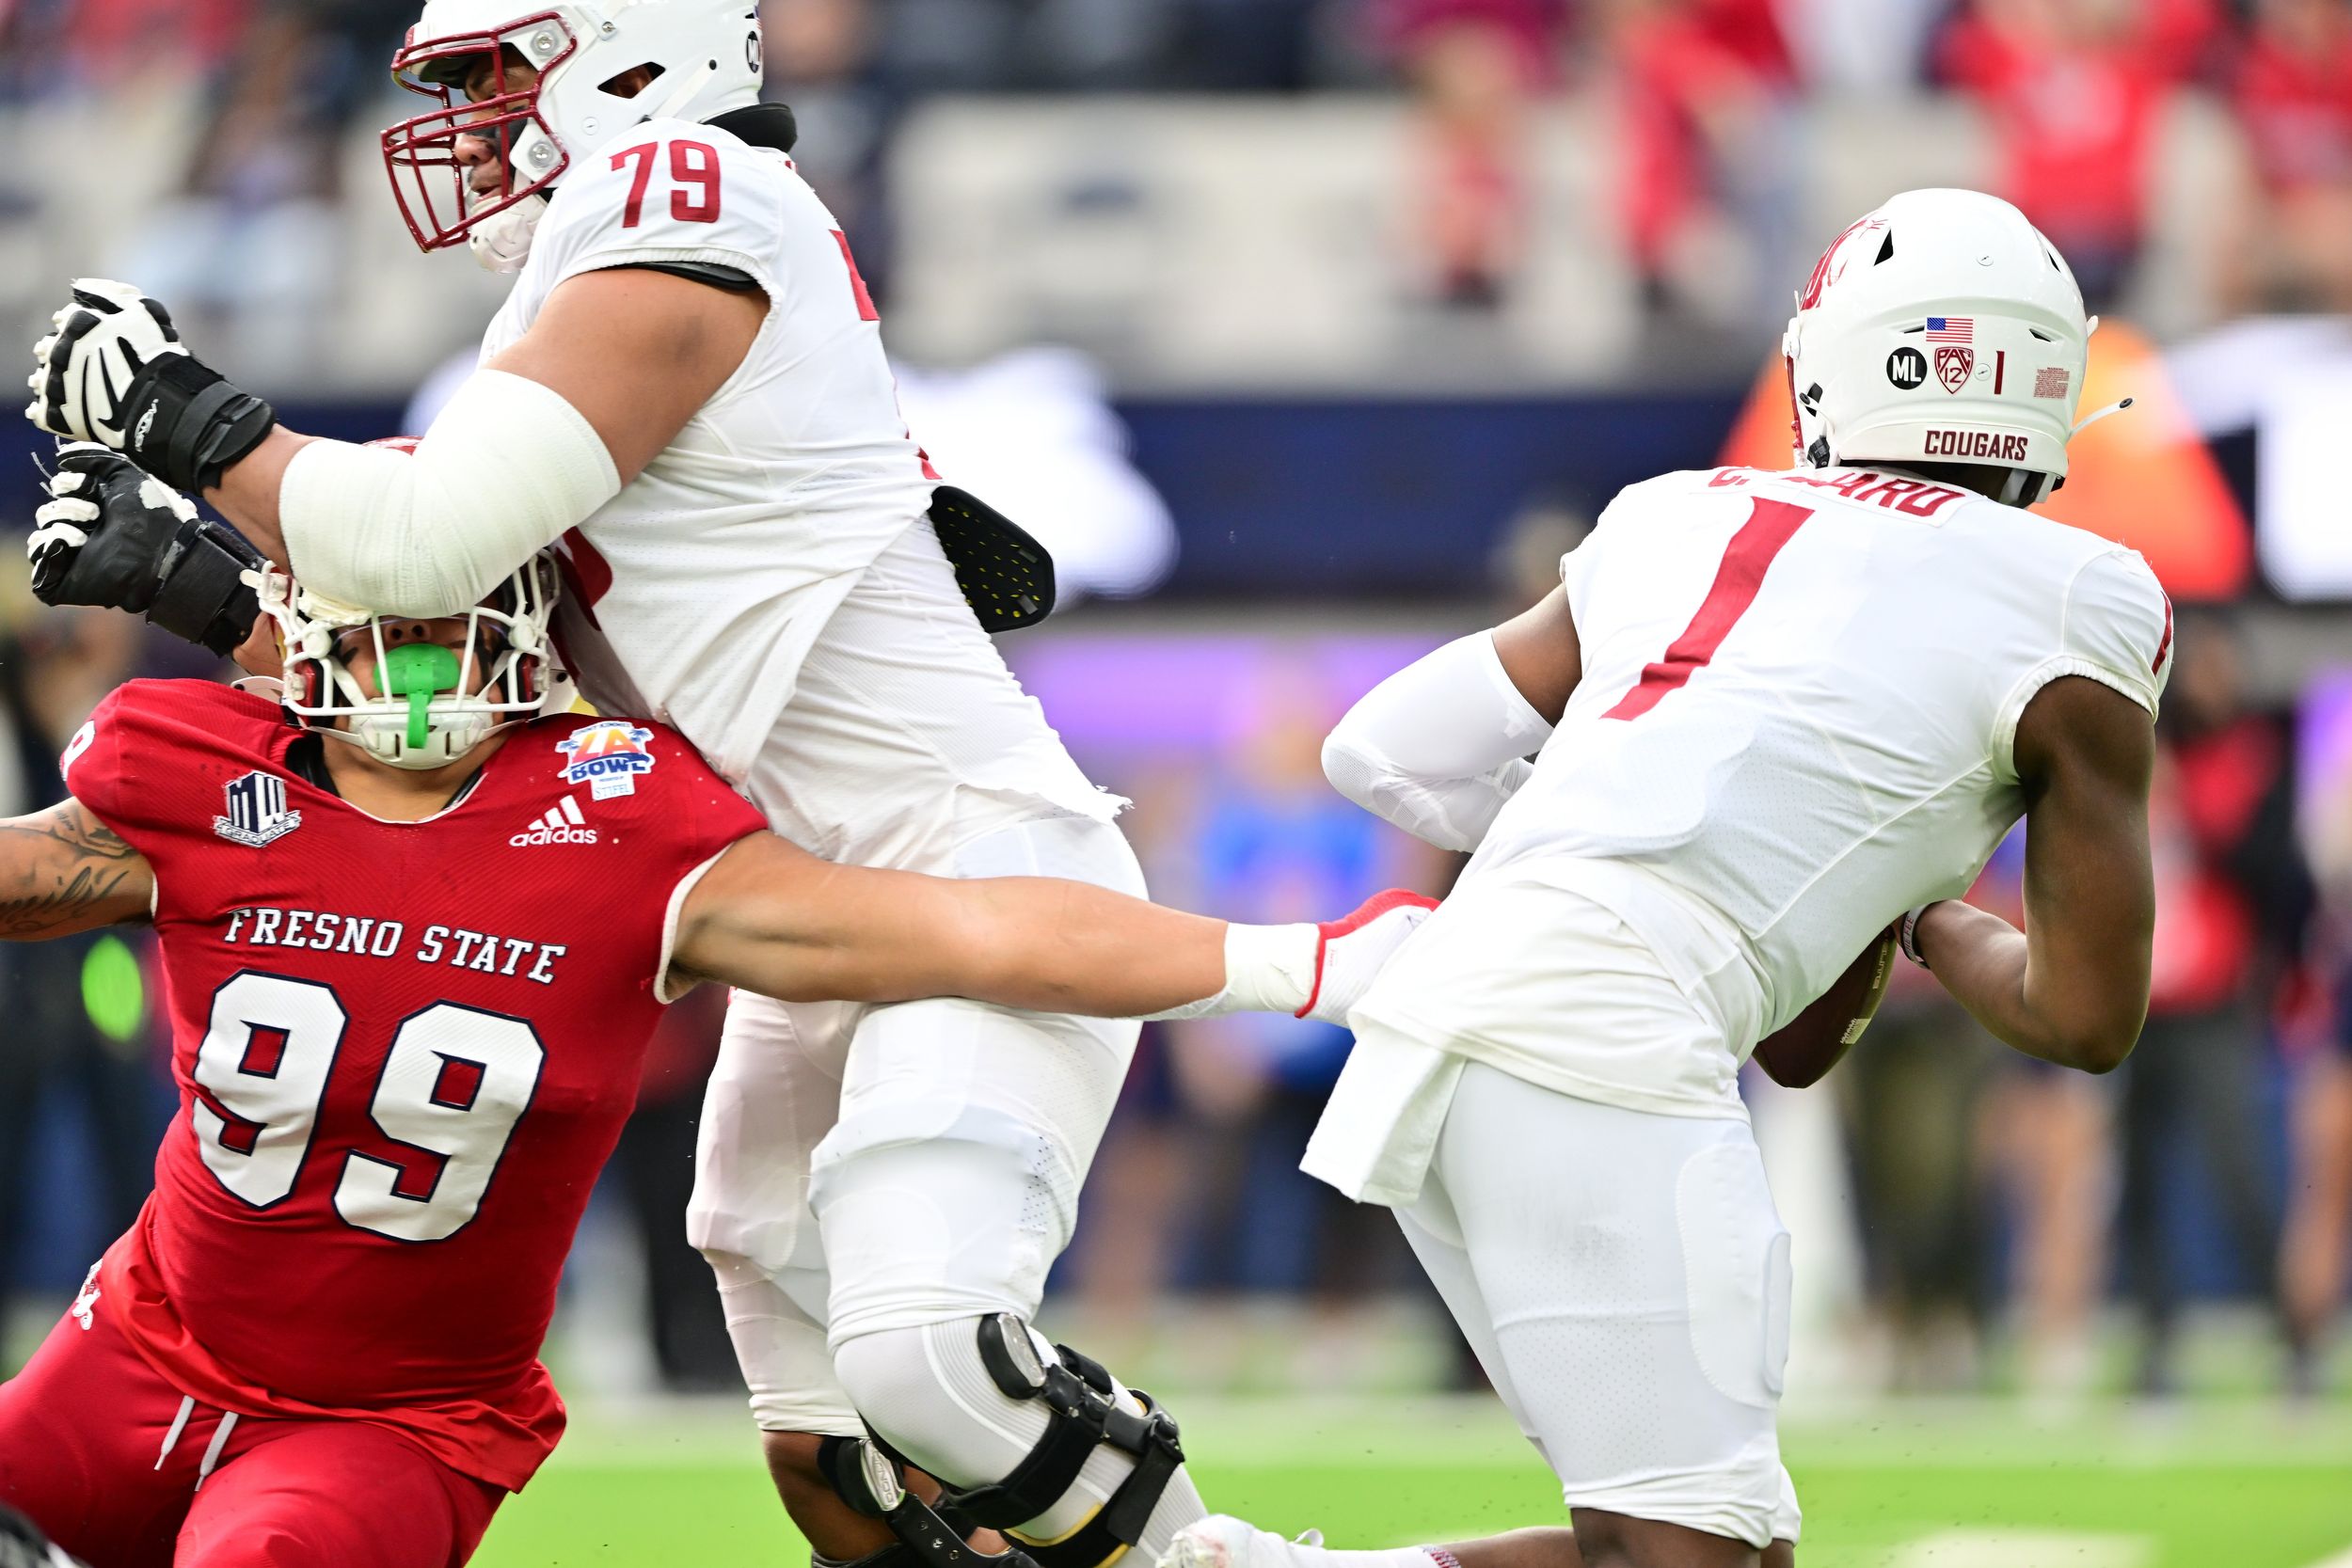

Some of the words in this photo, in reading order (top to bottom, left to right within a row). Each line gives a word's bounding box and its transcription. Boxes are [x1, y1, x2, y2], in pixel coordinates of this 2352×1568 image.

[609, 139, 721, 228] 79
[1892, 354, 1922, 383] ML
[1937, 348, 1971, 374] PAC
[1944, 367, 1963, 383] 12
[1994, 350, 2005, 395] 1
[1925, 430, 2028, 461] COUGARS
[1599, 496, 1816, 721] 1
[571, 728, 642, 764] LA
[571, 757, 646, 781] BOWL
[509, 824, 598, 847] adidas
[224, 907, 404, 958] FRESNO
[416, 925, 567, 985] STATE
[192, 968, 549, 1245] 99
